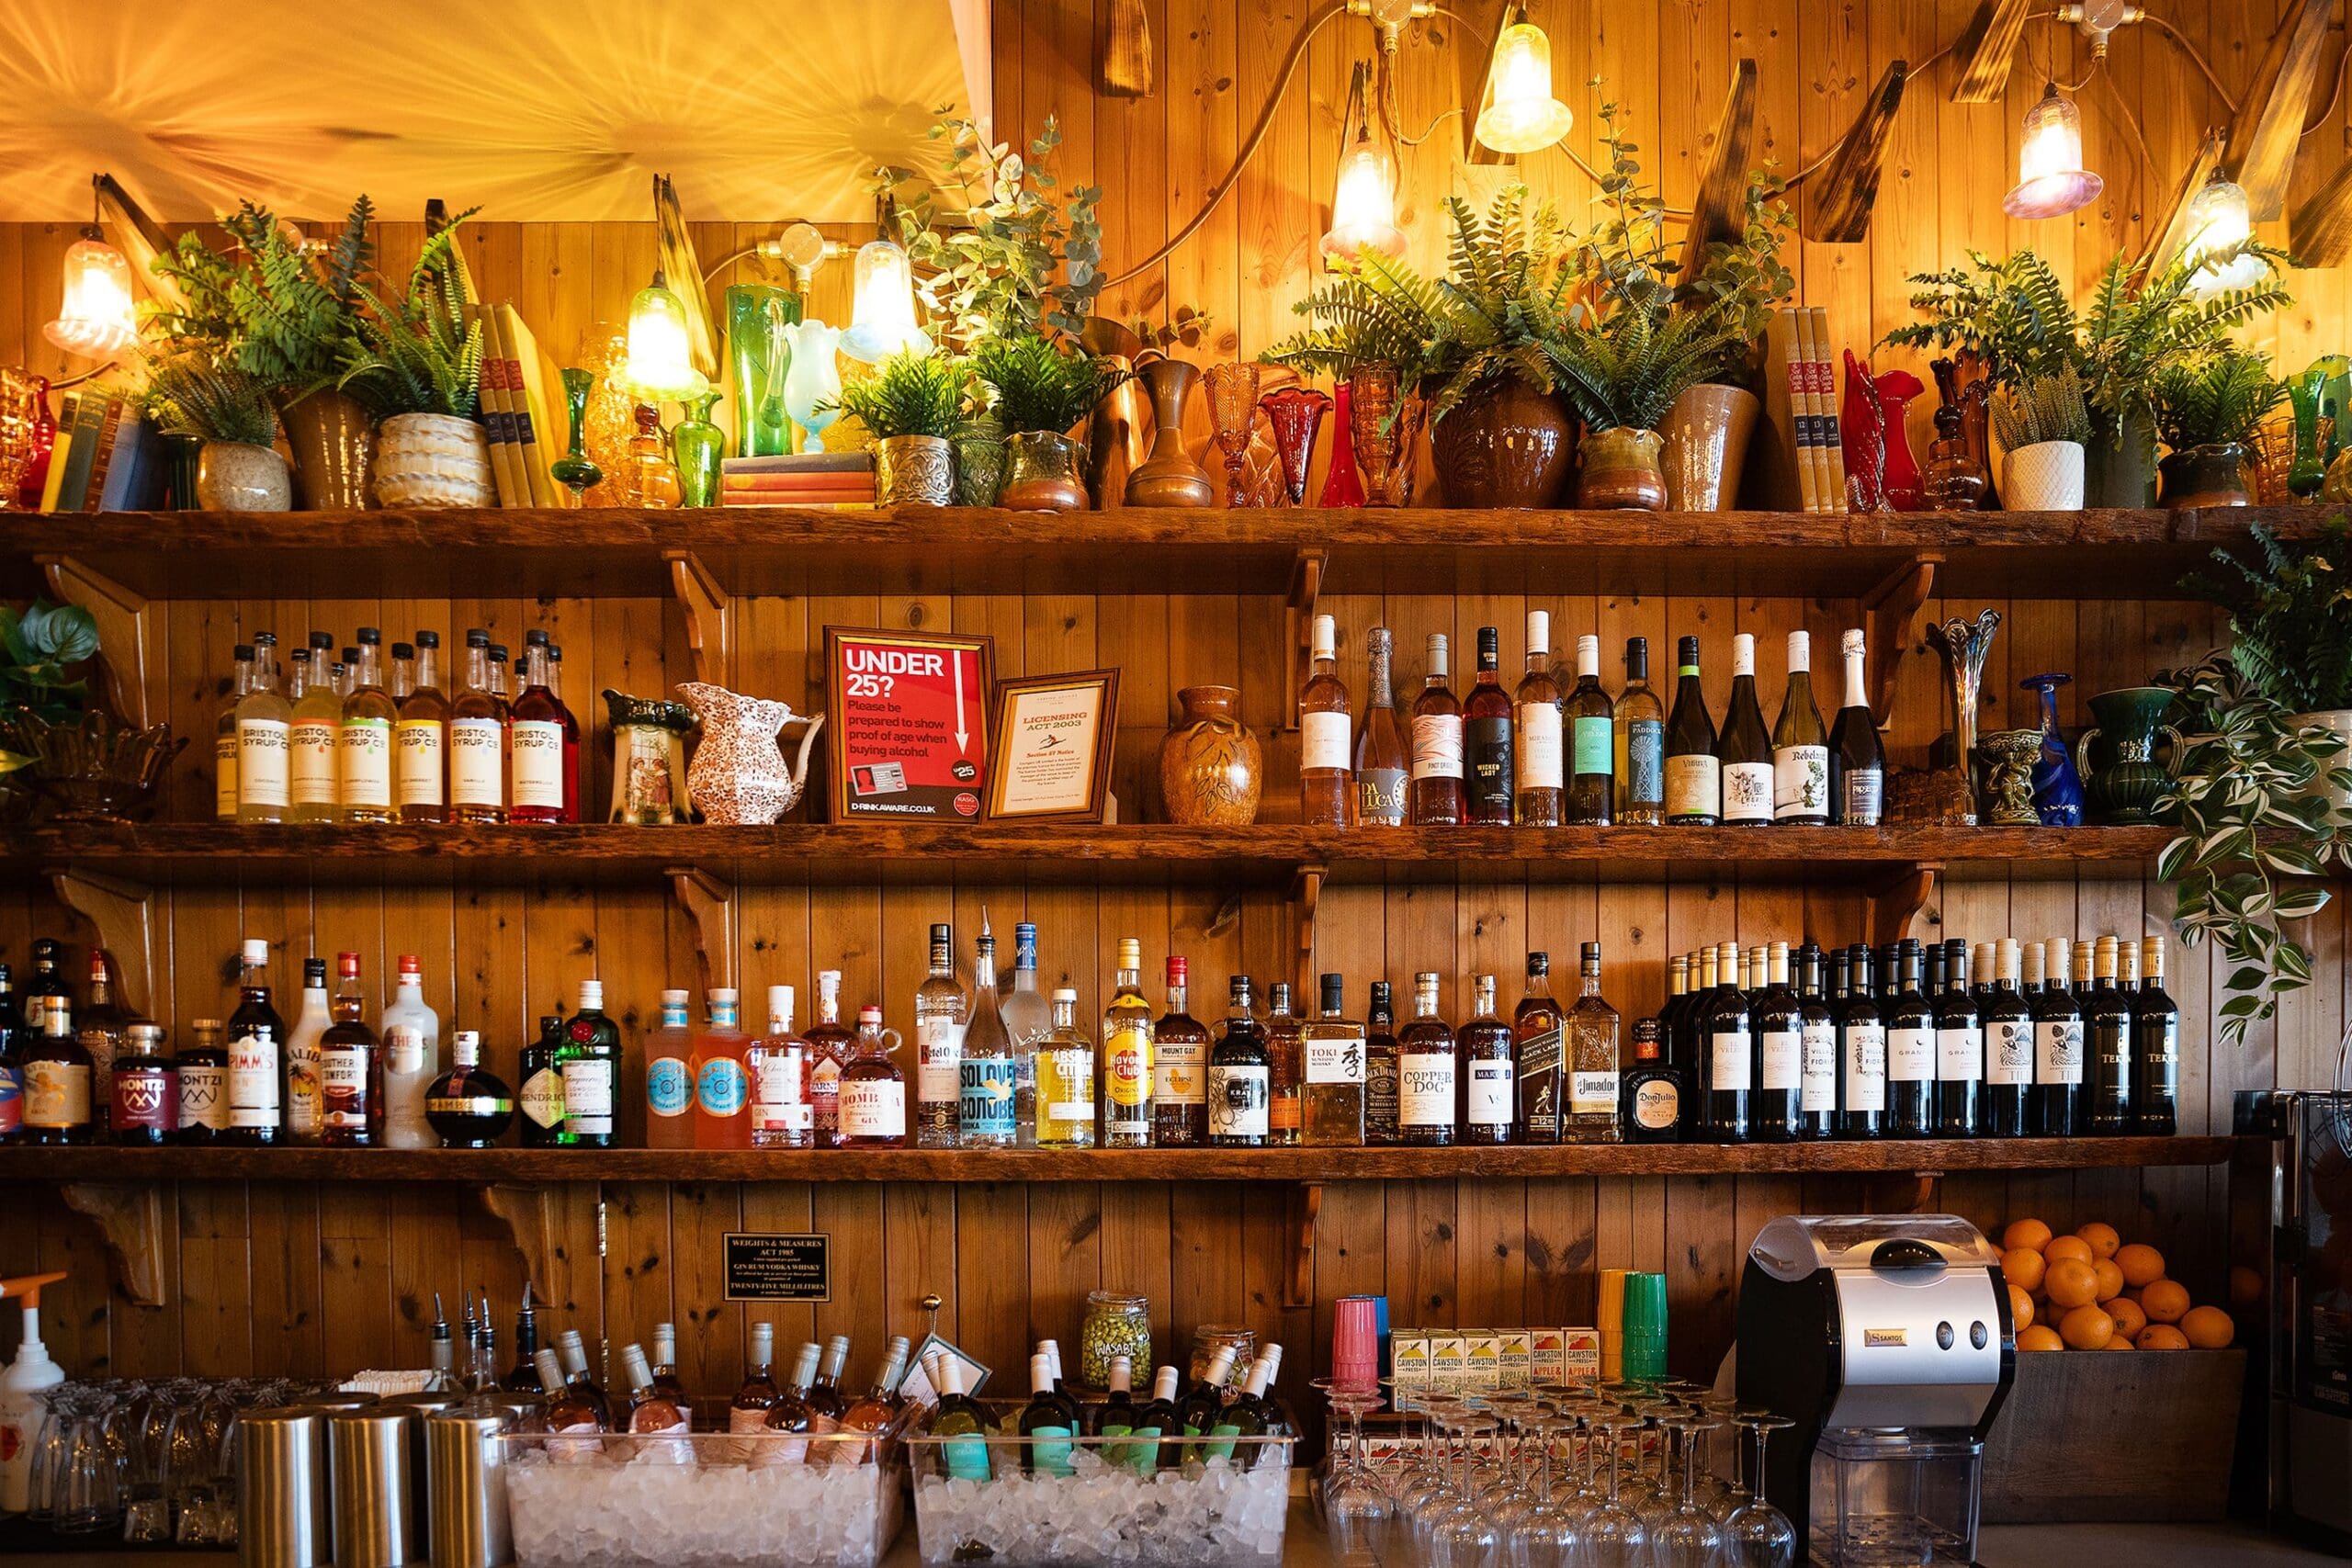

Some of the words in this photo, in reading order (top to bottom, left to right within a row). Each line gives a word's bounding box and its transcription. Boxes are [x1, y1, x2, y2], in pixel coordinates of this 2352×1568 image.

[1799, 421, 1806, 429] 12
[1814, 421, 1821, 429] 13
[845, 649, 944, 677] UNDER
[846, 673, 895, 698] 25?
[848, 700, 886, 712] Please
[888, 703, 901, 713] be
[849, 716, 899, 728] prepared
[902, 718, 912, 728] to
[914, 718, 944, 729] show
[1023, 711, 1088, 724] LICENSING
[1053, 720, 1082, 728] 2003
[243, 729, 287, 740] BRISTOL
[453, 729, 493, 739] BRISTOL
[514, 730, 554, 740] BRISTOL
[849, 731, 878, 742] proof
[880, 731, 892, 740] of
[893, 734, 914, 744] age
[916, 733, 947, 744] when
[243, 739, 278, 747] SYRUP
[453, 739, 483, 747] SYRUP
[514, 739, 544, 749] SYRUP
[849, 744, 888, 757] buying
[889, 746, 929, 758] alcohol
[1792, 750, 1815, 761] Rebel
[1362, 782, 1378, 795] DA
[1362, 794, 1395, 807] LUCA
[851, 803, 936, 814] DRINKAWARE.CO.UK
[921, 1045, 943, 1059] Ketel
[944, 1046, 959, 1058] Oe
[1520, 1049, 1542, 1061] BLACK
[1542, 1043, 1560, 1054] LABEL
[230, 1053, 274, 1070] PIMM'S
[1117, 1065, 1139, 1076] Club
[1404, 1071, 1452, 1084] COPPER
[1413, 1081, 1444, 1093] DOG
[1579, 1078, 1615, 1095] Jimador
[753, 1108, 768, 1117] GIN
[1095, 1343, 1137, 1356] WASABI
[1567, 1350, 1597, 1359] CAWSTON
[1396, 1359, 1428, 1368] CAWSTON
[1433, 1358, 1463, 1367] CAWSTON
[1467, 1358, 1498, 1367] CAWSTON
[1499, 1354, 1529, 1363] CAWSTON
[1533, 1367, 1555, 1376] APPLE
[1555, 1367, 1562, 1375] &
[1567, 1367, 1589, 1376] APPLE
[1589, 1367, 1597, 1375] &
